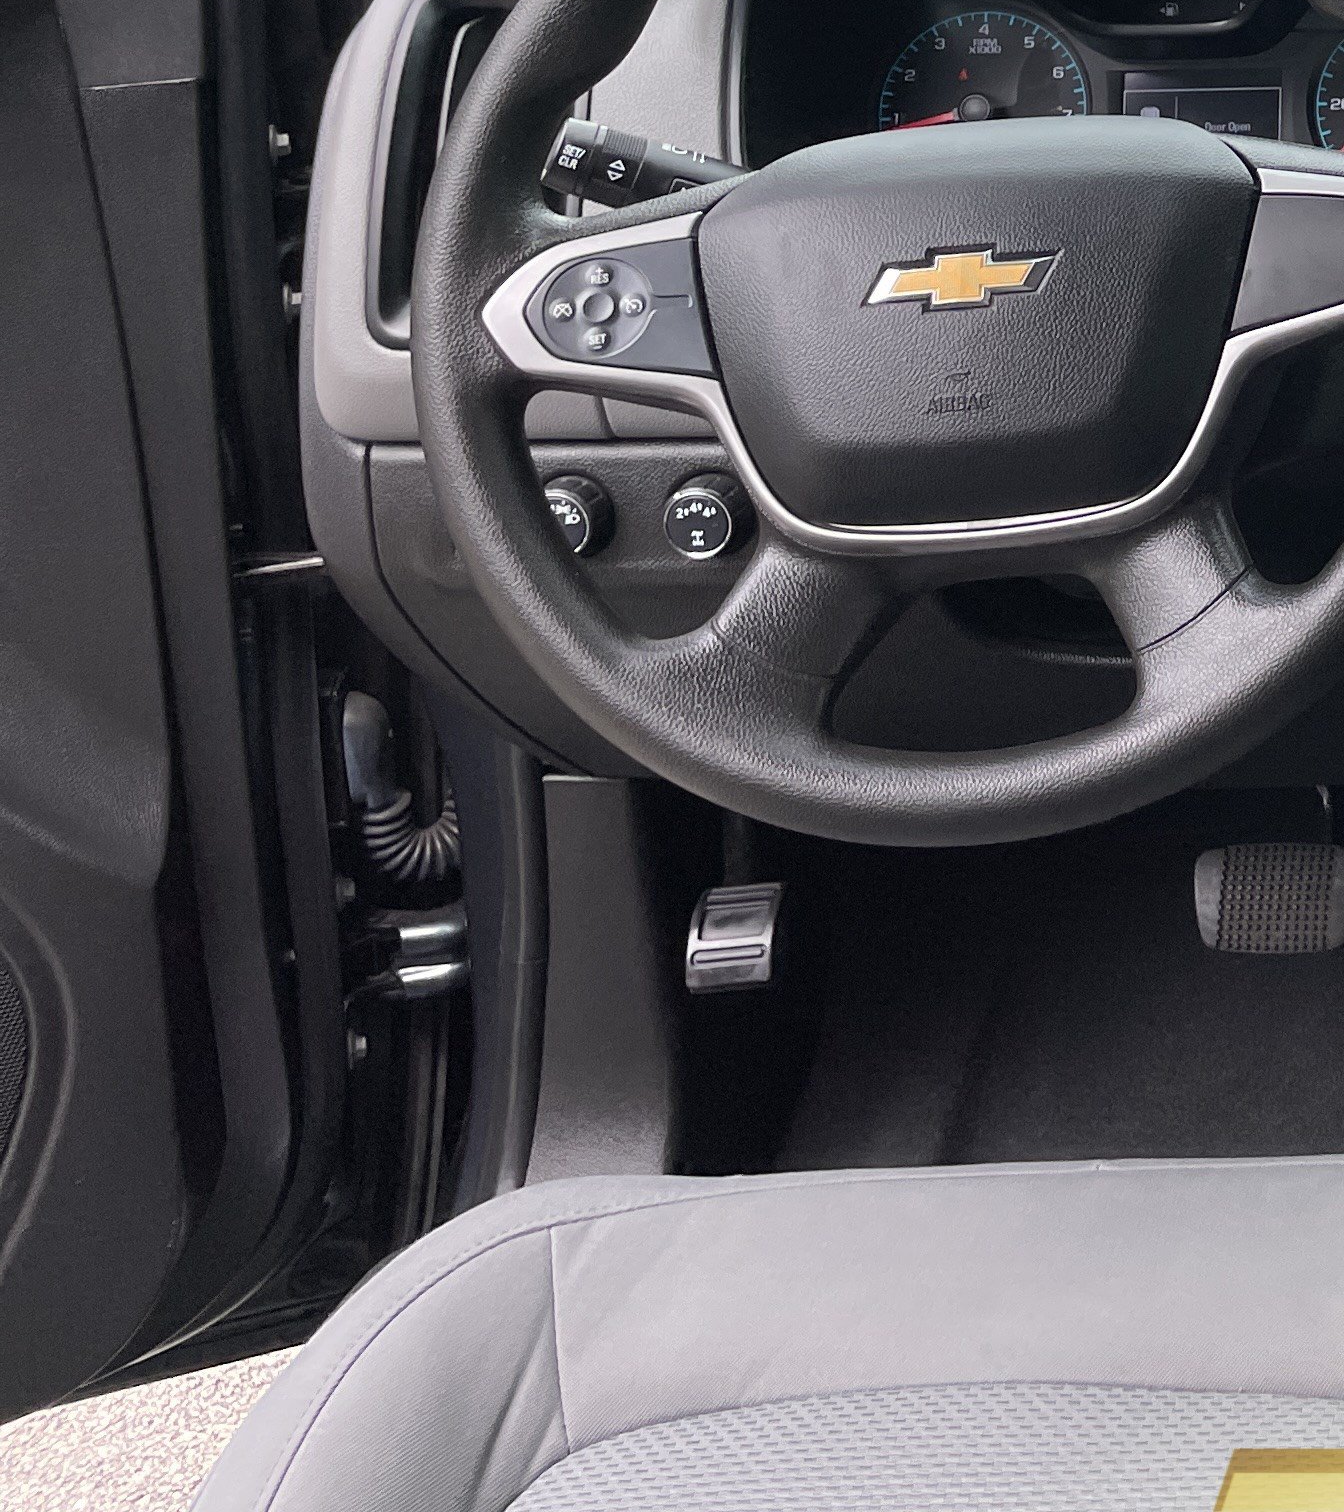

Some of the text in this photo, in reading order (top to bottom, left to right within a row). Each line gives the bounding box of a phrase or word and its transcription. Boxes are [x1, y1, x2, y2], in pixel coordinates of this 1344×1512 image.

[979, 23, 989, 35] 4
[935, 38, 946, 50] 3
[1024, 36, 1035, 49] 5
[904, 69, 916, 82] 2
[1052, 66, 1064, 79] 6
[1227, 121, 1251, 133] Open
[557, 155, 579, 170] CLR
[588, 333, 607, 346] SET
